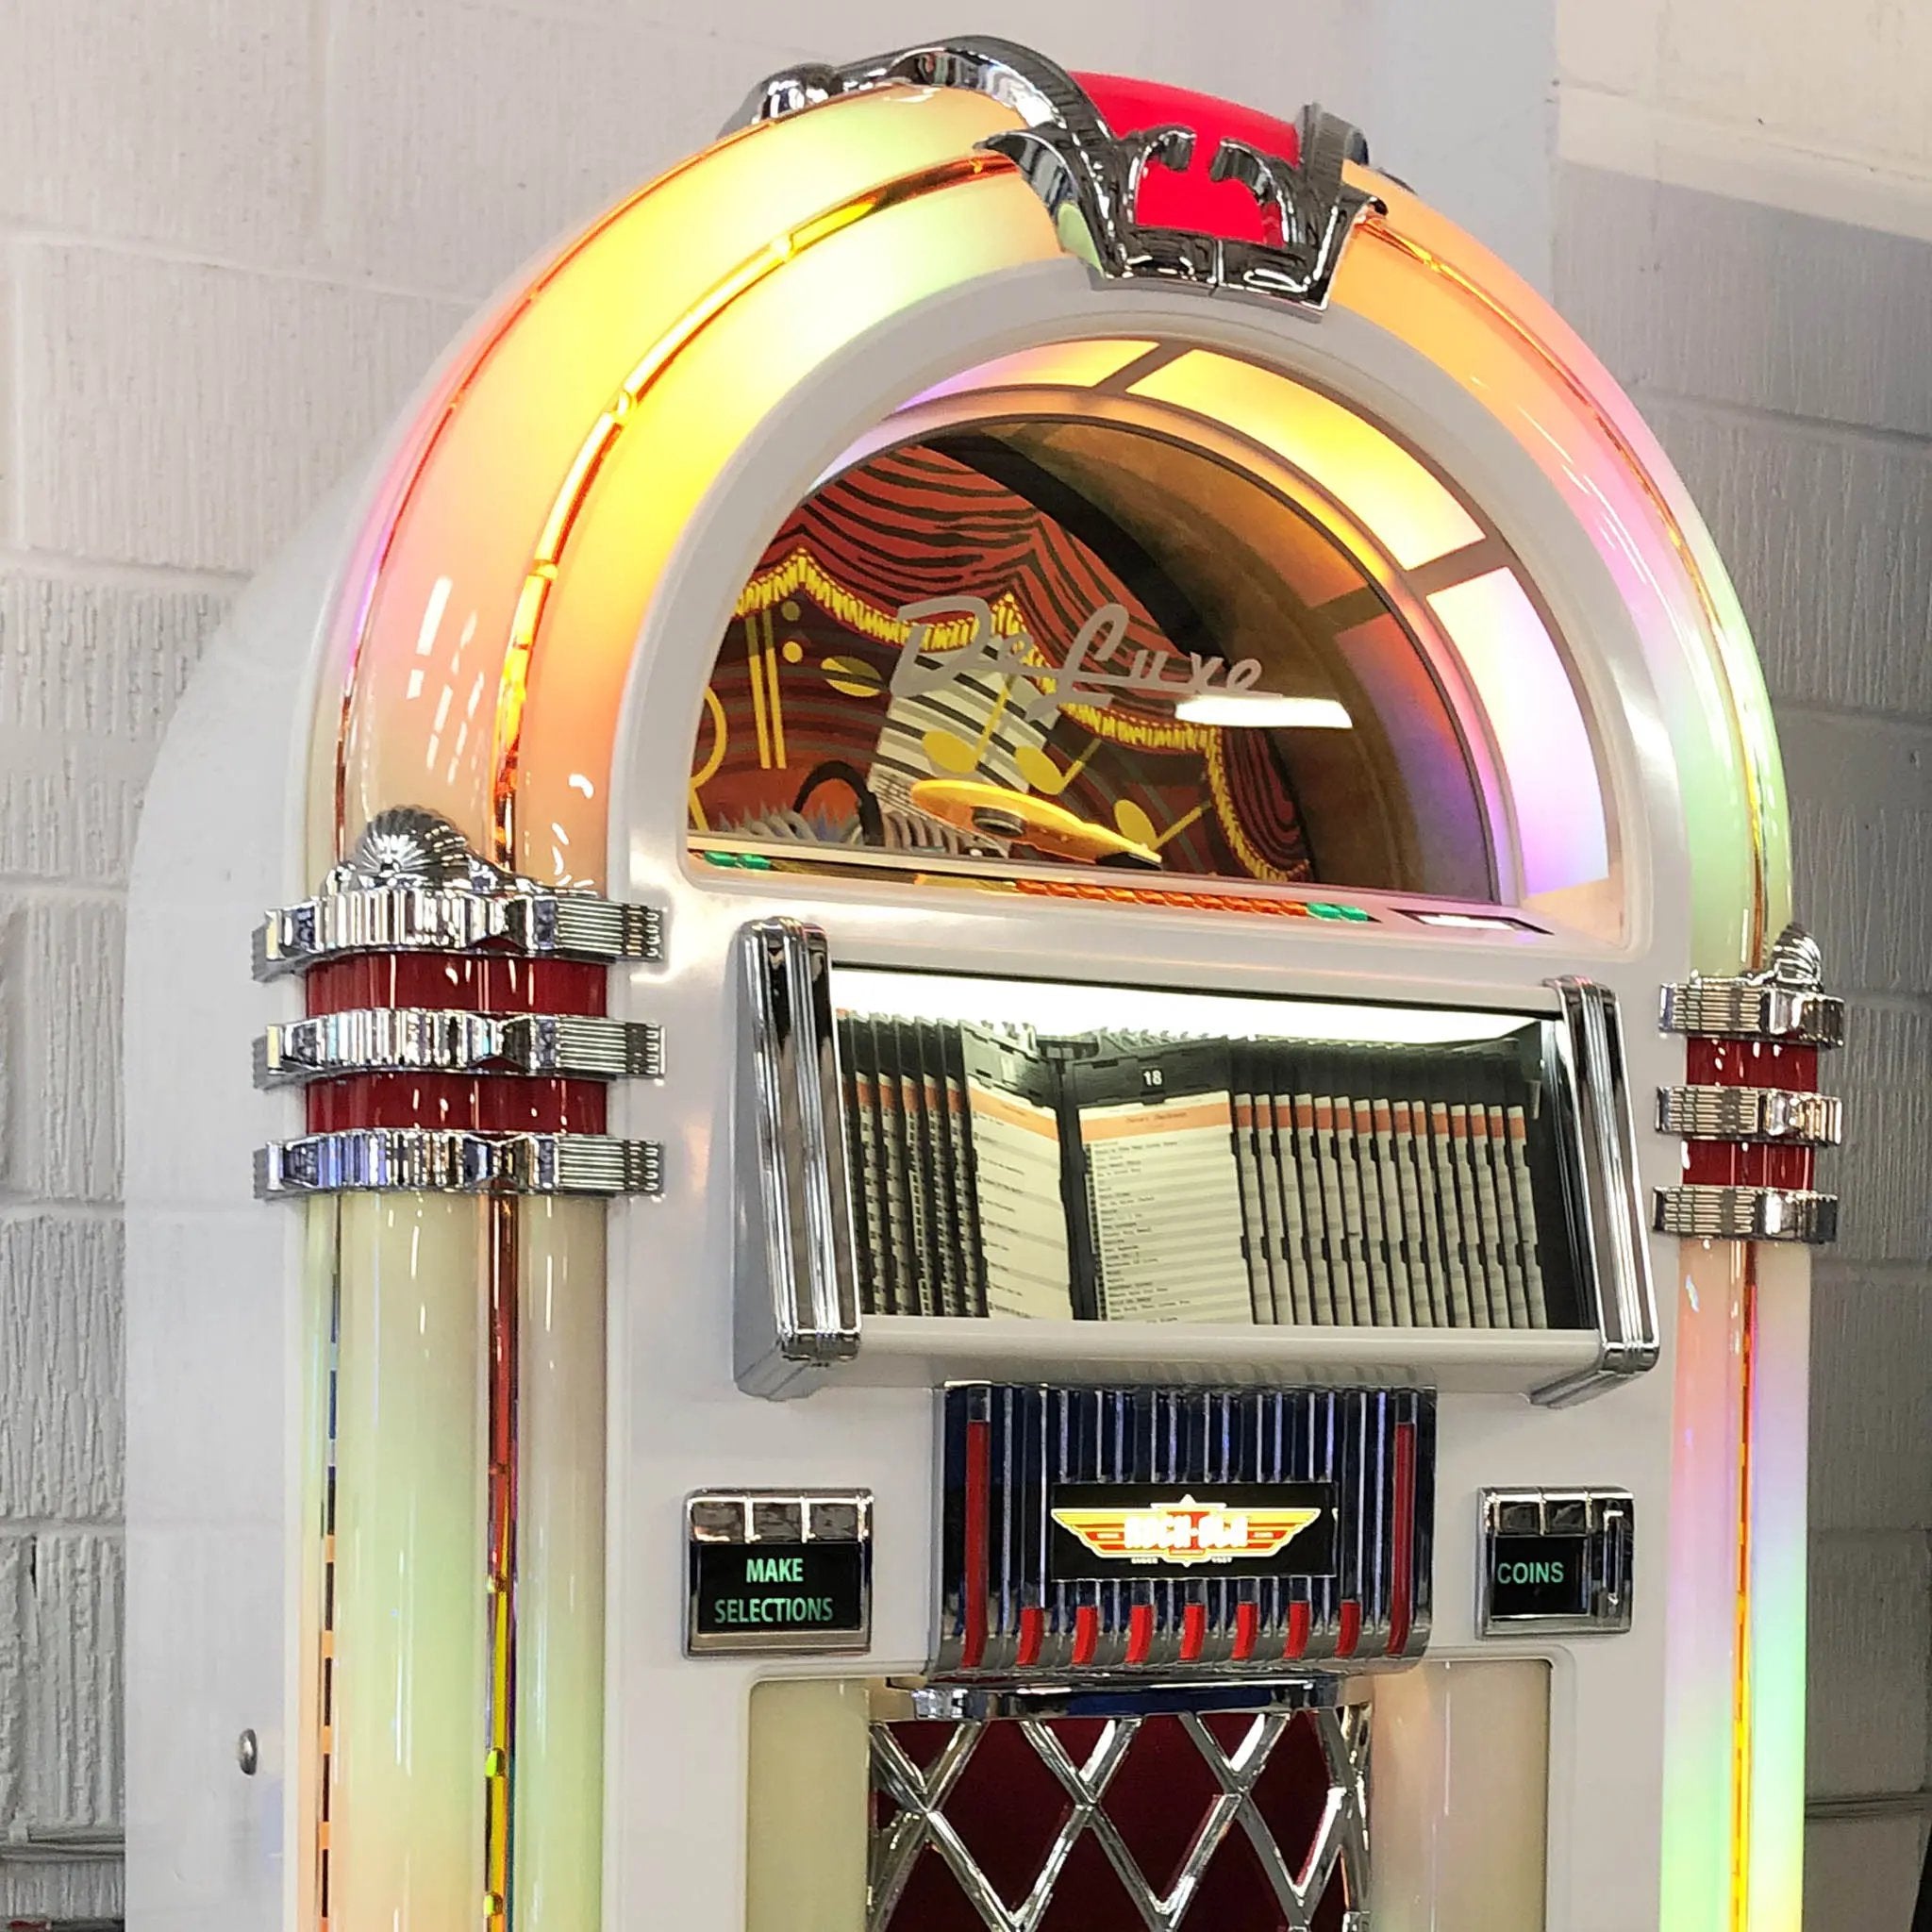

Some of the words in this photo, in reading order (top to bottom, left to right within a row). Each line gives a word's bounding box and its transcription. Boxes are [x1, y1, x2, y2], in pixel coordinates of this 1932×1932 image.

[1142, 1070, 1162, 1086] 18
[746, 1557, 804, 1583] MAKE
[1497, 1561, 1564, 1585] COINS
[714, 1597, 833, 1624] SELECTIONS
